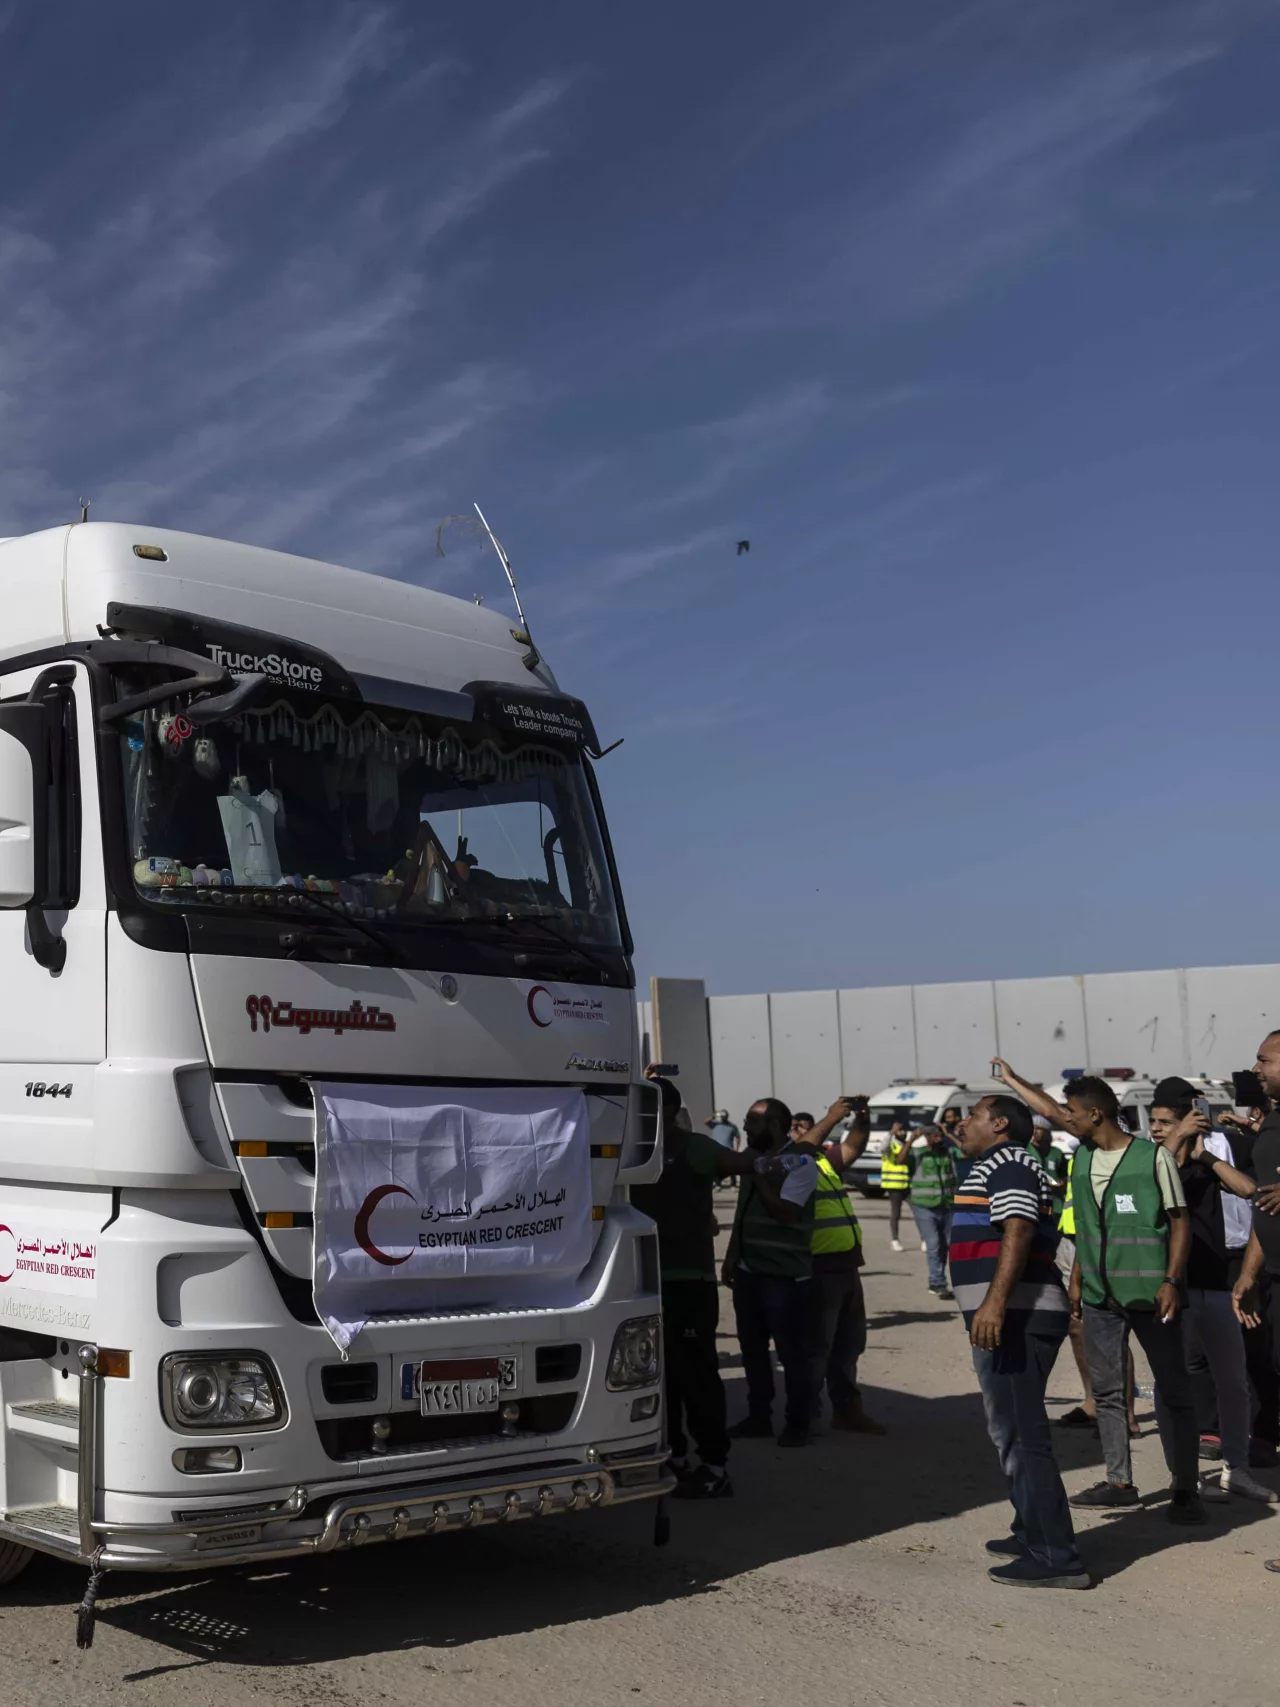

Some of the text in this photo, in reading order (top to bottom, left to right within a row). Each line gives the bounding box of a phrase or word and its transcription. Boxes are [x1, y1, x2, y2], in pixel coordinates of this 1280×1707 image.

[206, 643, 322, 683] TruckStore
[223, 666, 321, 692] eres-Benz
[513, 716, 578, 742] Leader company
[246, 821, 262, 847] 1
[25, 1081, 73, 1099] 1844
[475, 1192, 527, 1220] الأحمر
[527, 1188, 567, 1212] الهلال
[419, 1216, 564, 1248] EGYPTIAN RED CRESCENT
[42, 1238, 70, 1257] الأحمر
[71, 1242, 96, 1261] الهلال
[16, 1258, 96, 1280] EGYPTIAN RED CRESCENT
[1, 1297, 91, 1329] Mercedes-Benz
